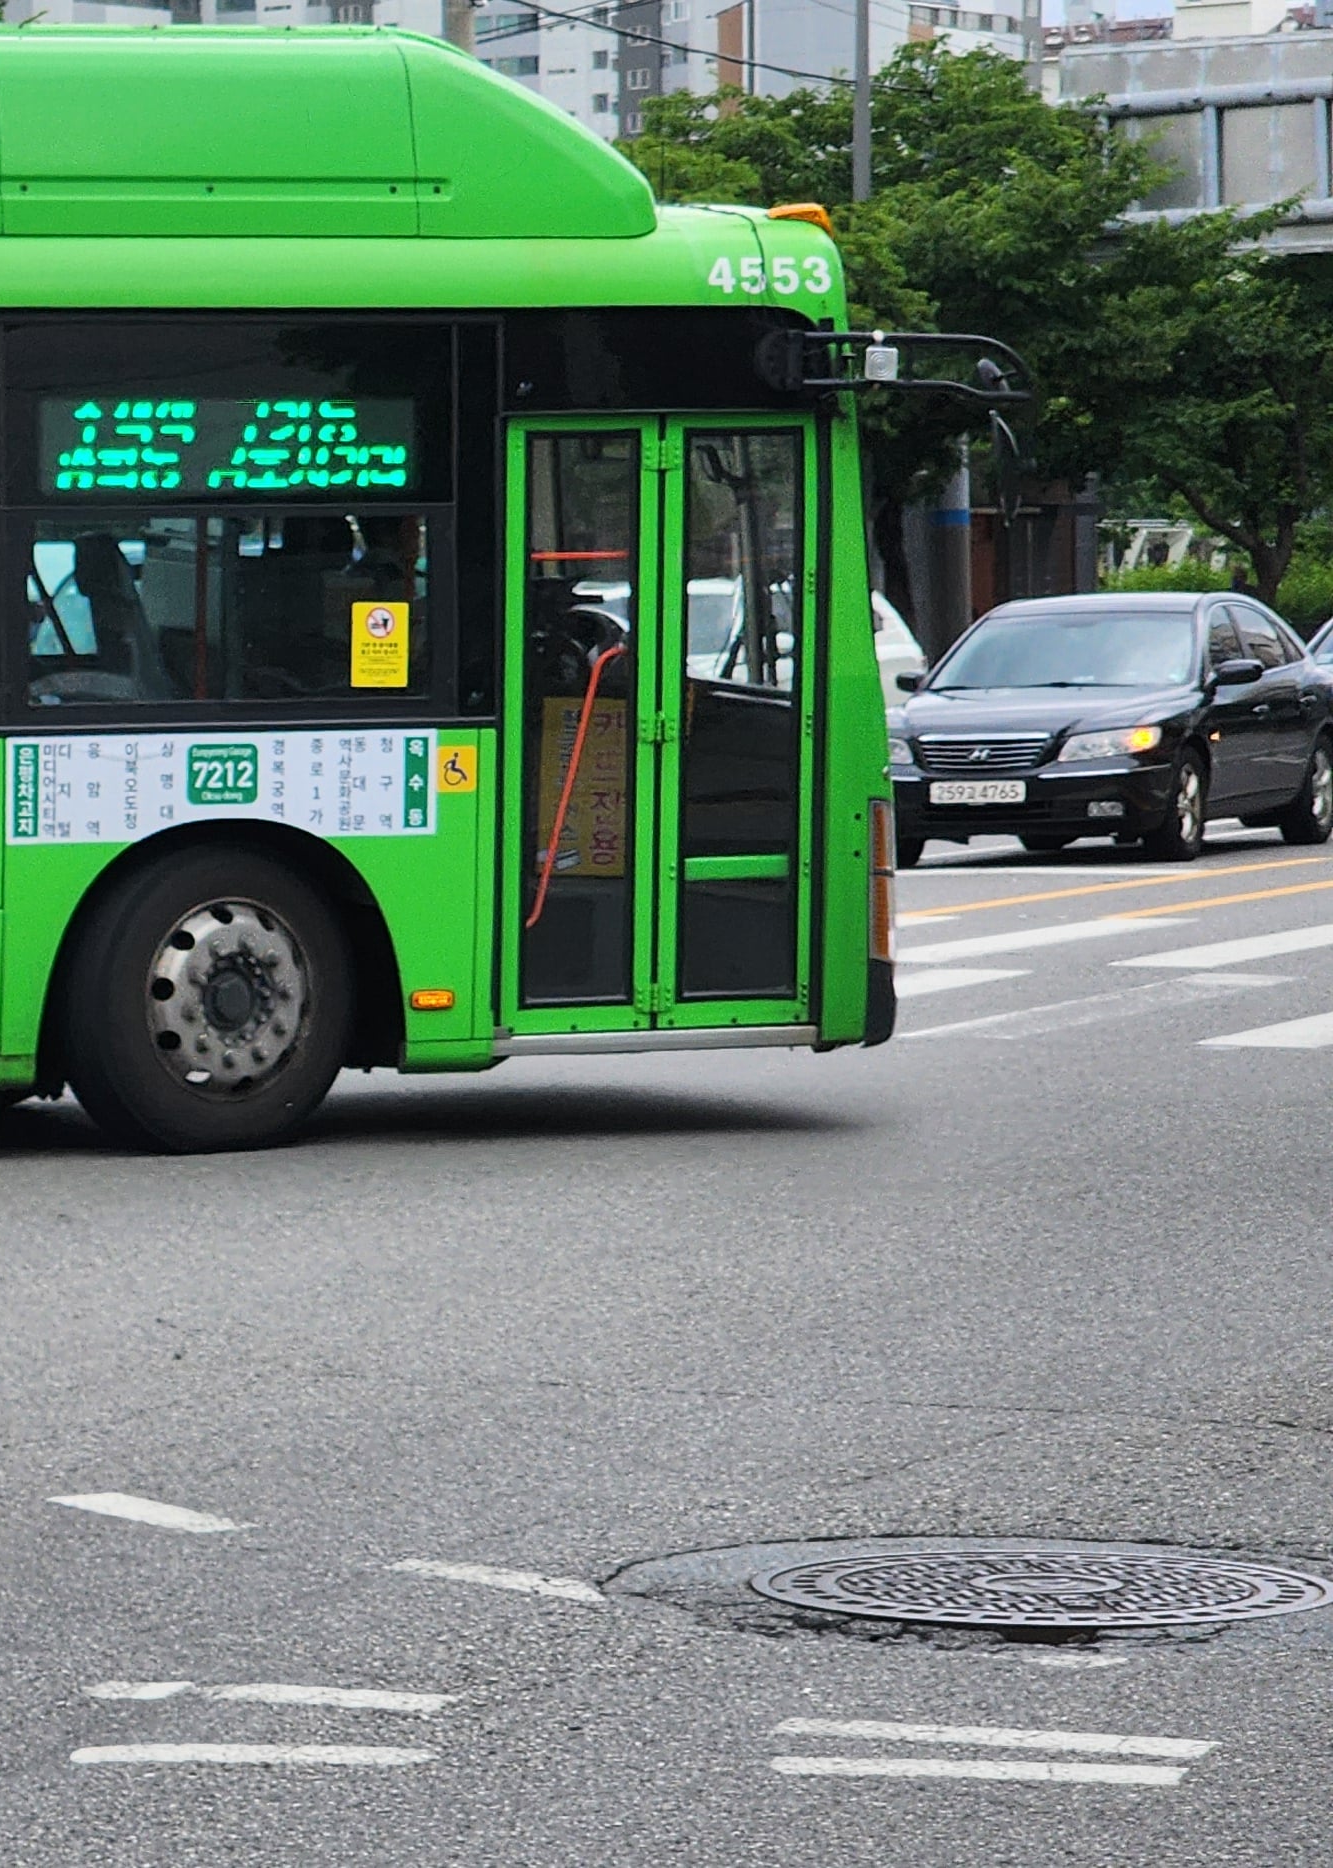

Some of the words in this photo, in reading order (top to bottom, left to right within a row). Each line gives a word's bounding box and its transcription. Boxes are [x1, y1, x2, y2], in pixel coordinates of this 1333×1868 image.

[708, 256, 832, 294] 4553
[18, 747, 34, 836] 은평차고지
[43, 743, 56, 838] 미디어시티역
[58, 743, 71, 838] 디지털
[87, 742, 101, 836] 응암역
[160, 741, 174, 820] 상명대
[192, 760, 254, 788] 7212
[271, 739, 285, 818] 경복궁역
[310, 738, 324, 825] 종로1가
[353, 736, 366, 831] 동대문
[379, 736, 393, 829] 청구역
[408, 739, 424, 826] 옥수동
